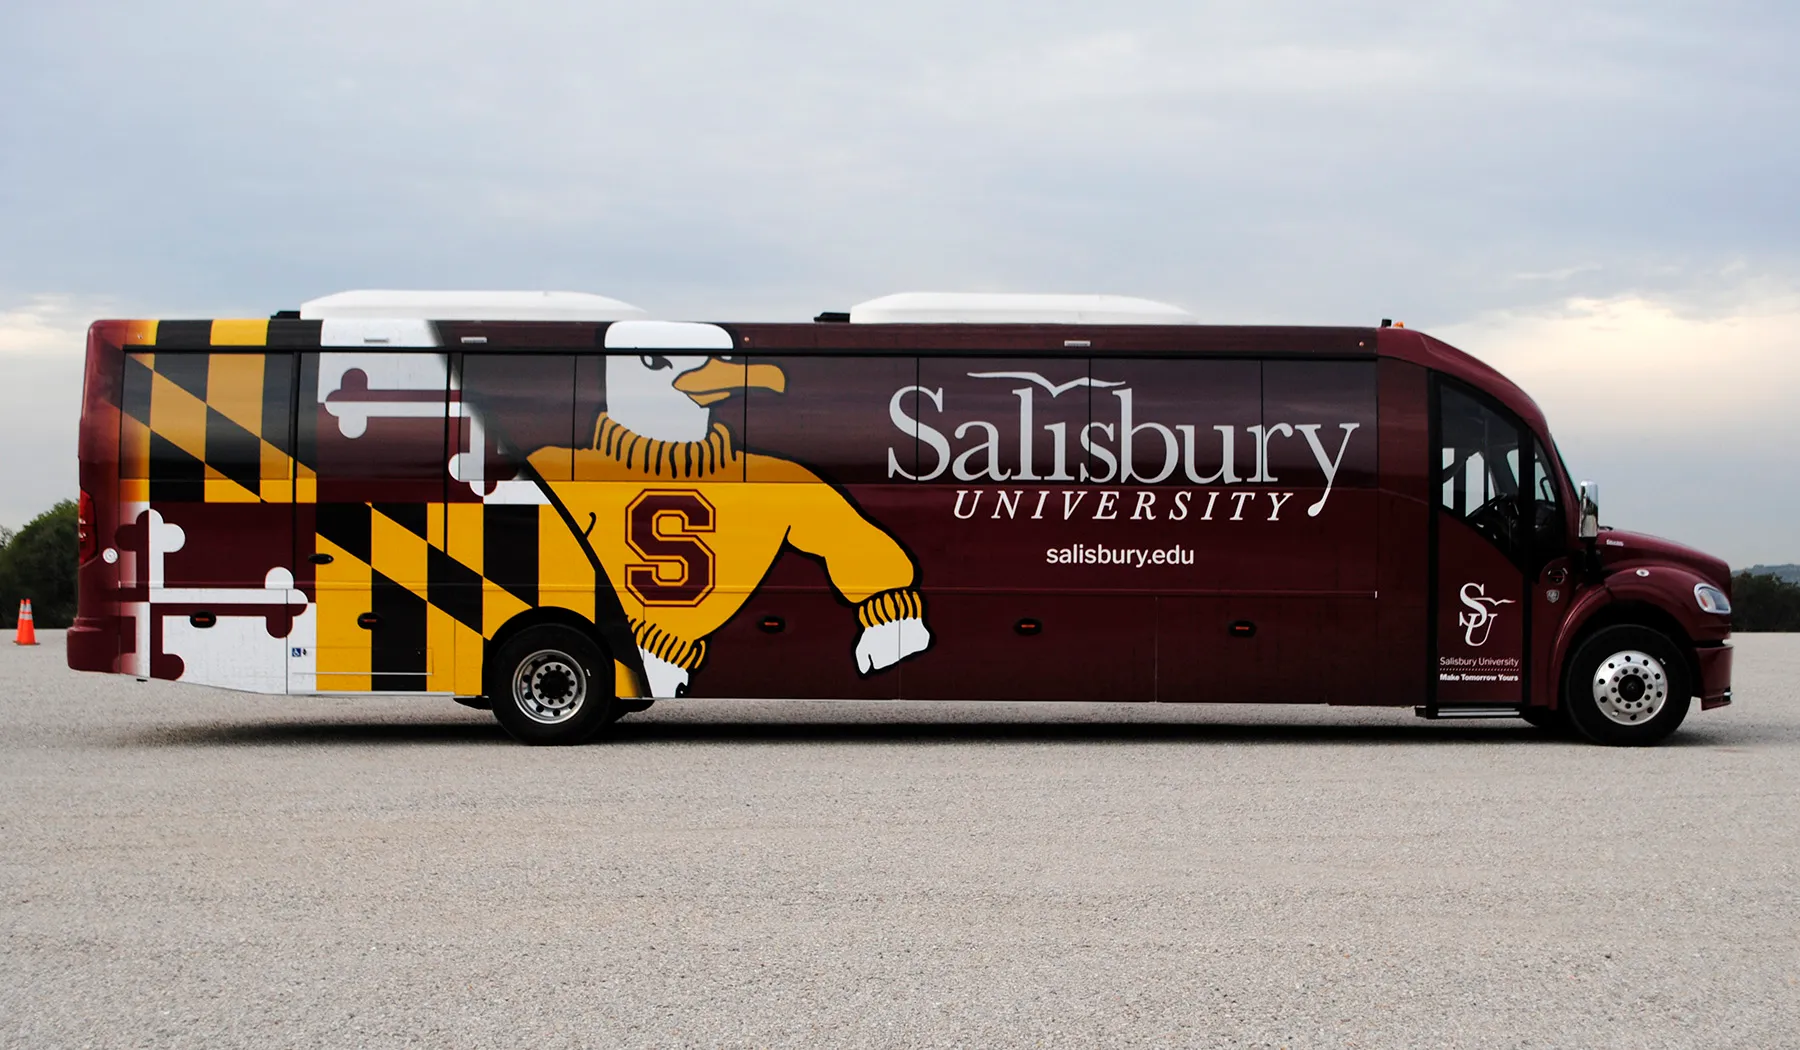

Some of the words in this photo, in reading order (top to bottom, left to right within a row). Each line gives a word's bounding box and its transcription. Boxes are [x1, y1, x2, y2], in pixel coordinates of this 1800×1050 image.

[887, 384, 1361, 517] Salisbury
[952, 489, 1294, 521] UNIVERSITY
[625, 489, 716, 607] S
[1046, 544, 1195, 568] salisbury.edu
[1440, 656, 1477, 667] Salisbury
[1478, 657, 1519, 667] University
[1440, 673, 1460, 681] Make
[1461, 673, 1497, 681] Tomorrow
[1498, 673, 1519, 681] Yours
